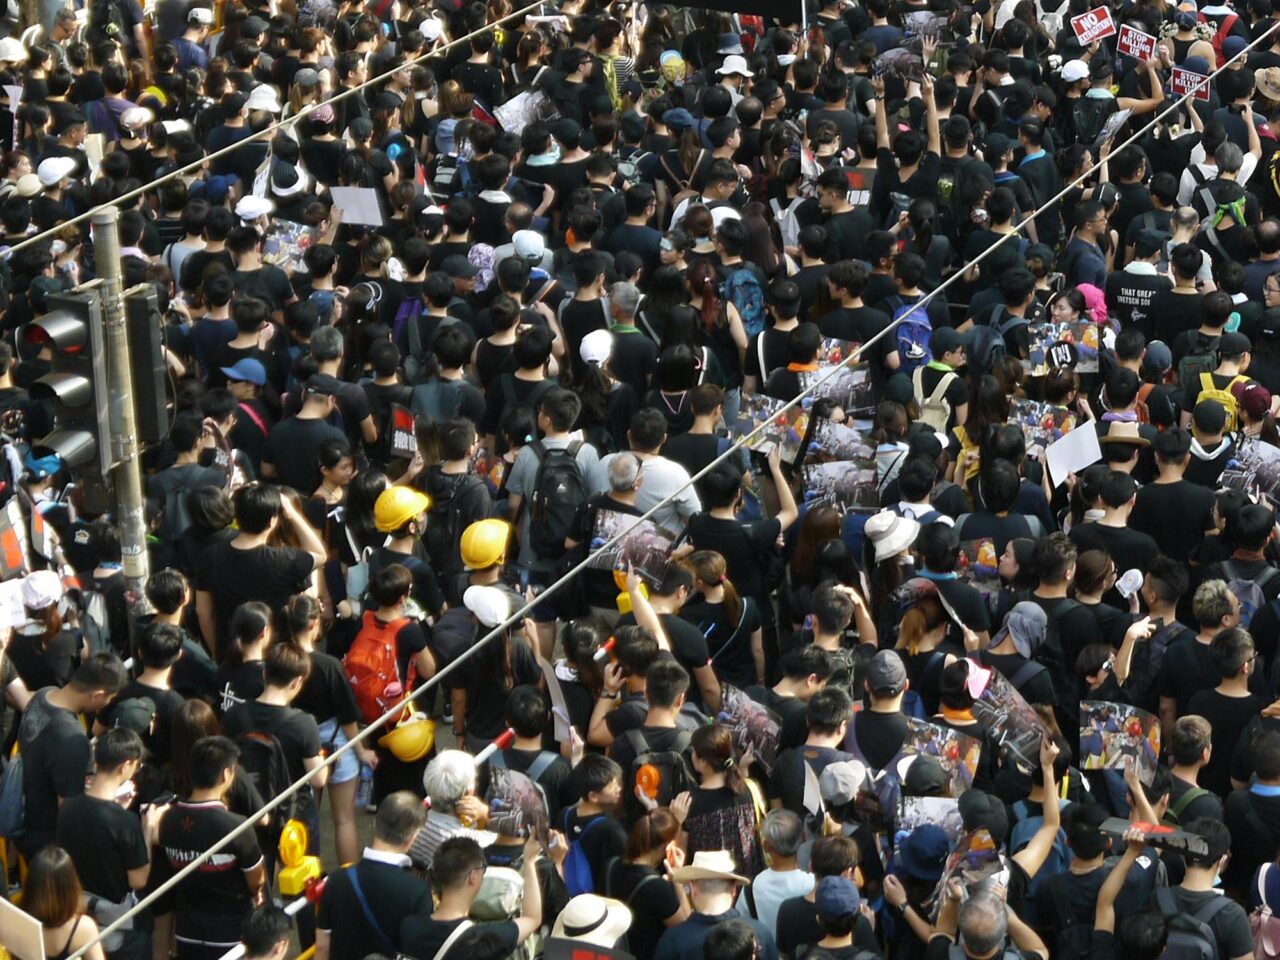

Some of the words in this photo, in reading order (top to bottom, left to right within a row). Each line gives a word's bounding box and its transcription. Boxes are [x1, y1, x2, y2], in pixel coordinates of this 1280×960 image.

[1079, 13, 1098, 31] NO
[1127, 30, 1148, 43] STOP
[1121, 35, 1151, 54] KILLING
[1129, 46, 1140, 57] US
[1180, 71, 1201, 83] STOP
[1121, 287, 1136, 297] THAT
